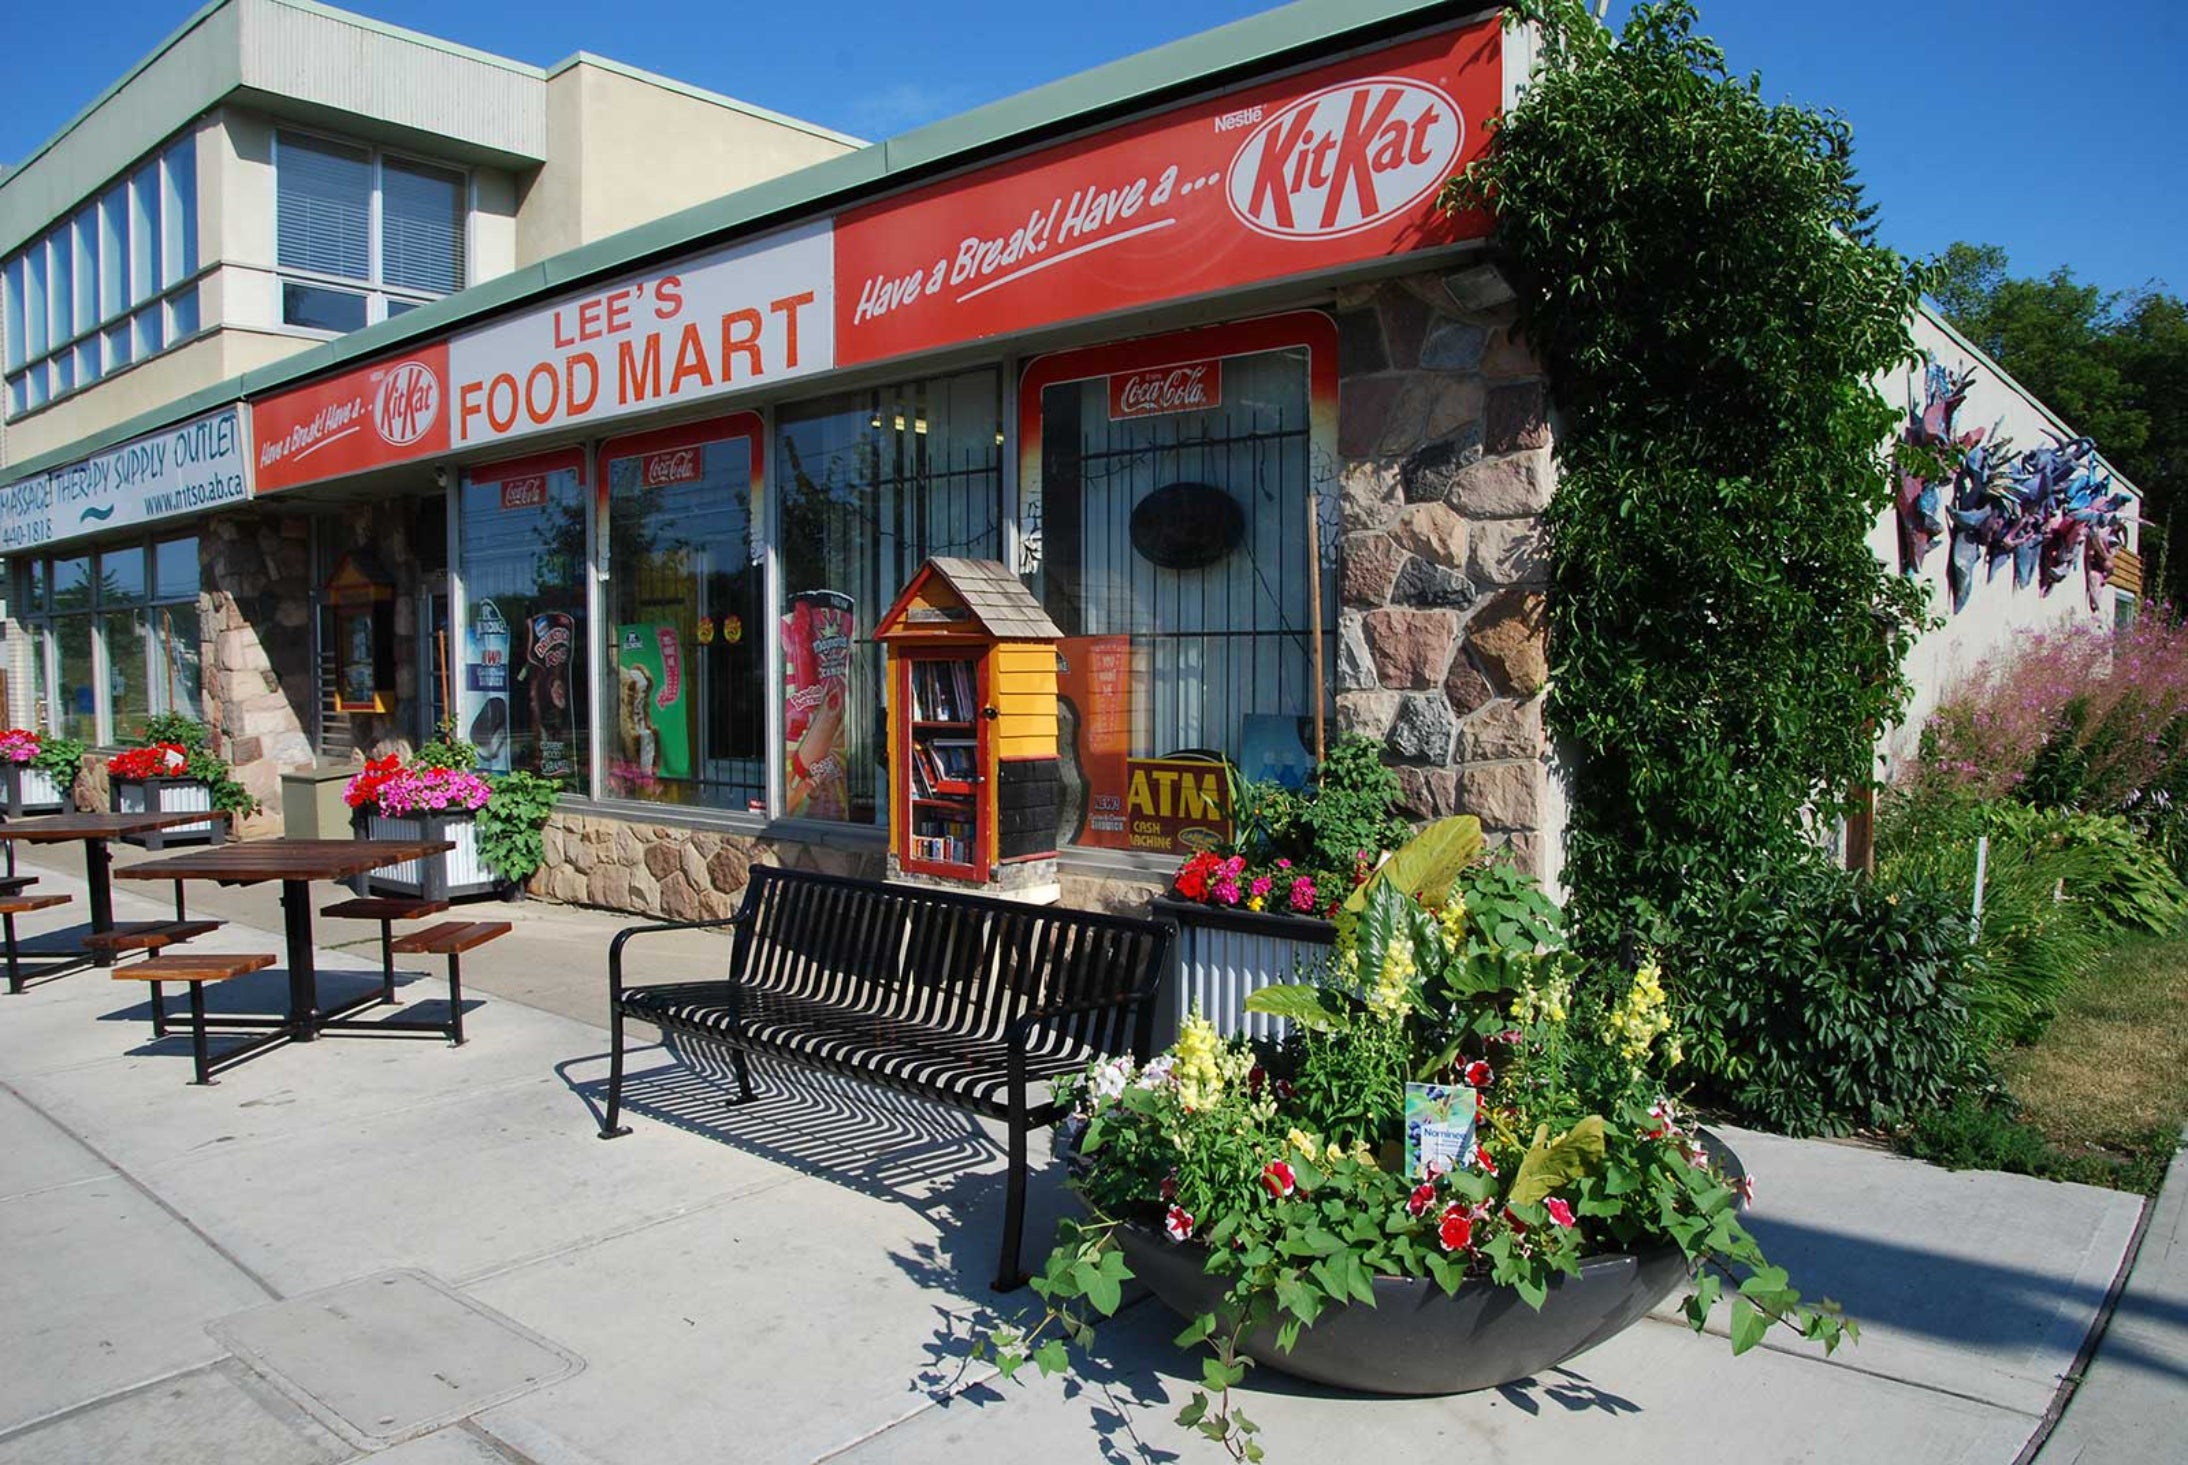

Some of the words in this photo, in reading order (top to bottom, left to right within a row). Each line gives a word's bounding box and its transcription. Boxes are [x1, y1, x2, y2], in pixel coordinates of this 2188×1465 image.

[1214, 106, 1262, 133] Nestlé
[1248, 88, 1441, 229] KitKat
[854, 269, 924, 325] Have
[925, 259, 947, 295] a
[950, 198, 1061, 286] Break!
[1057, 178, 1148, 243] Have
[553, 275, 683, 349] LEE'S
[460, 351, 599, 440] FOOD
[618, 290, 815, 405] MART
[1121, 366, 1206, 412] Coca-Cola
[260, 440, 284, 469] Have
[291, 409, 326, 452] Break!
[325, 402, 350, 434] Have
[381, 367, 433, 440] KitKat
[114, 440, 167, 489] SUPPLY
[174, 414, 237, 468] OUTLET
[1128, 769, 1221, 821] ATM
[1133, 820, 1161, 834] CASH
